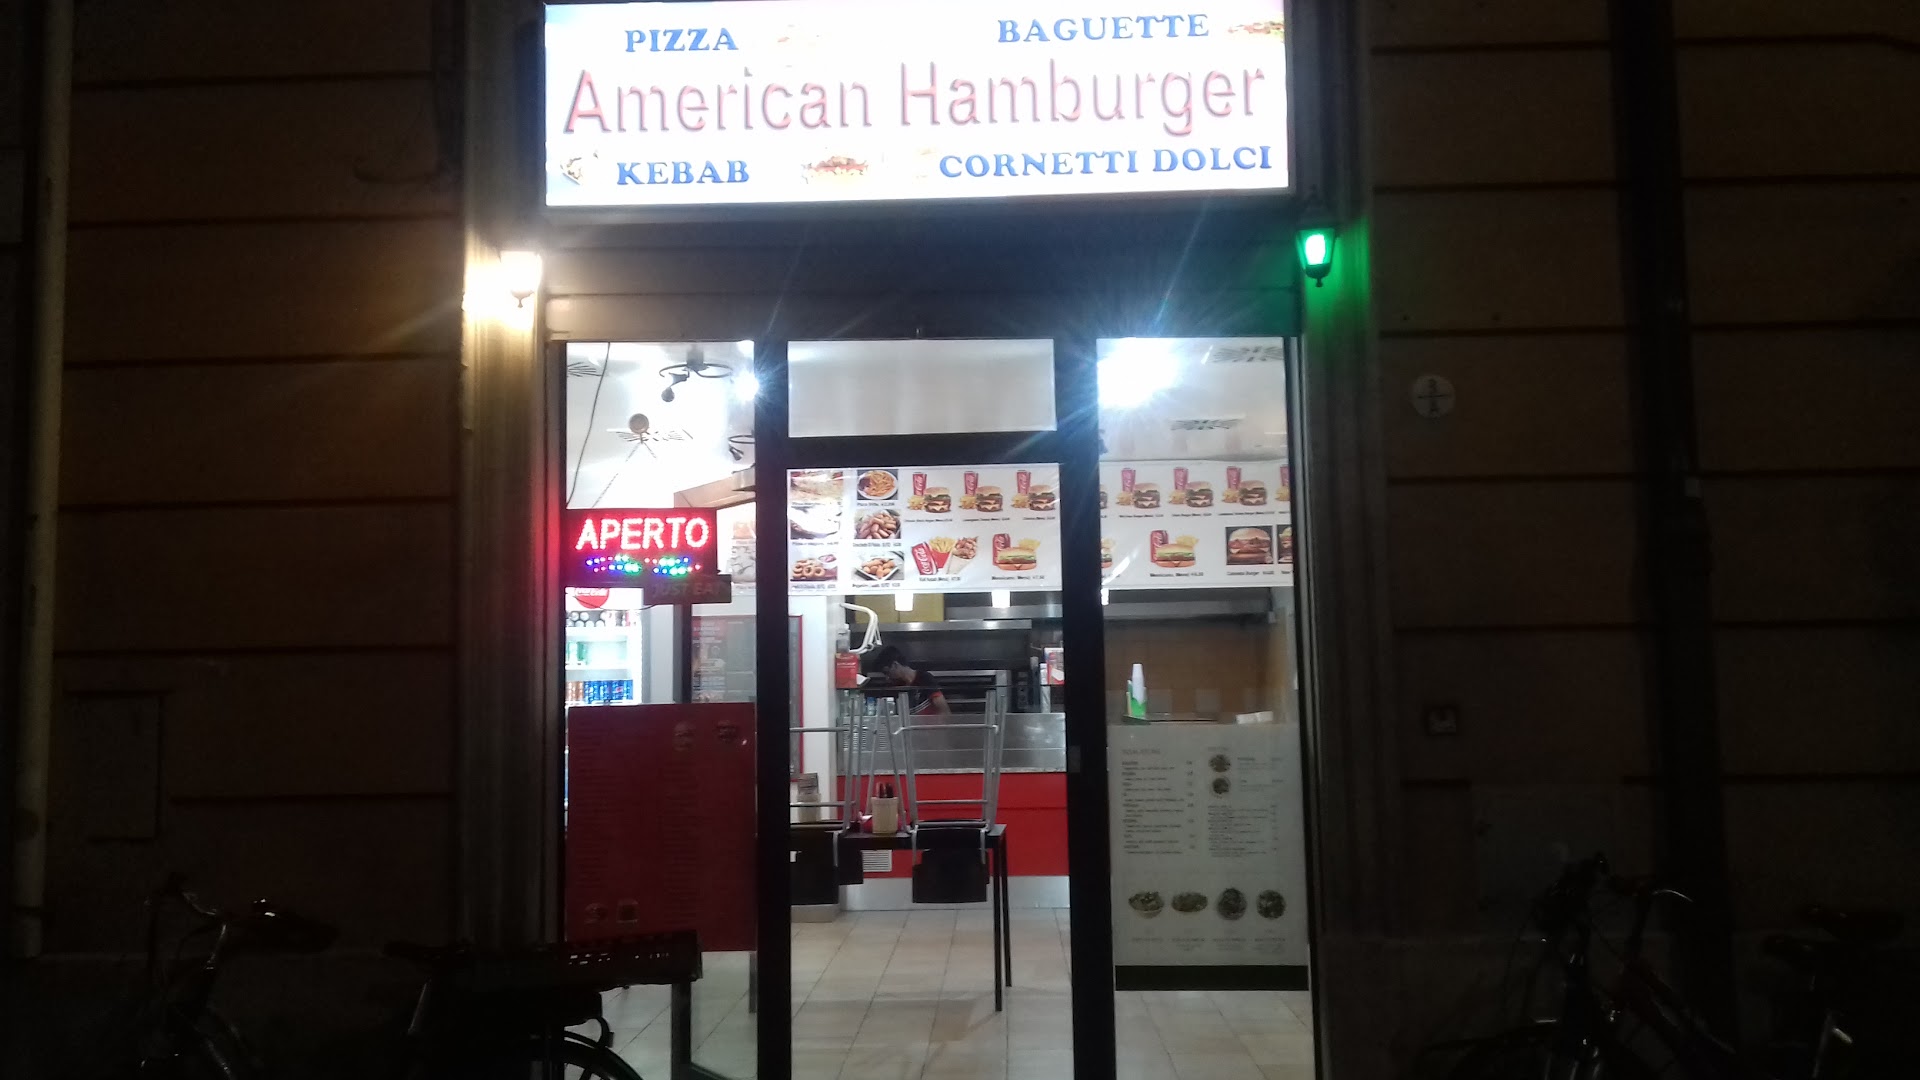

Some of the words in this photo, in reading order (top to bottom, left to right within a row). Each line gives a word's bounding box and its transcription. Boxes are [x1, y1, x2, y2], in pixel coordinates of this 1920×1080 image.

[626, 28, 738, 53] PIZZA
[998, 14, 1210, 43] BAGUETTE
[563, 67, 873, 134] American
[901, 59, 1265, 137] Hamburger
[616, 160, 750, 186] KEBAB
[939, 151, 1138, 179] CORNETTI
[1153, 145, 1272, 173] DOLCI
[575, 517, 710, 550] APERTO
